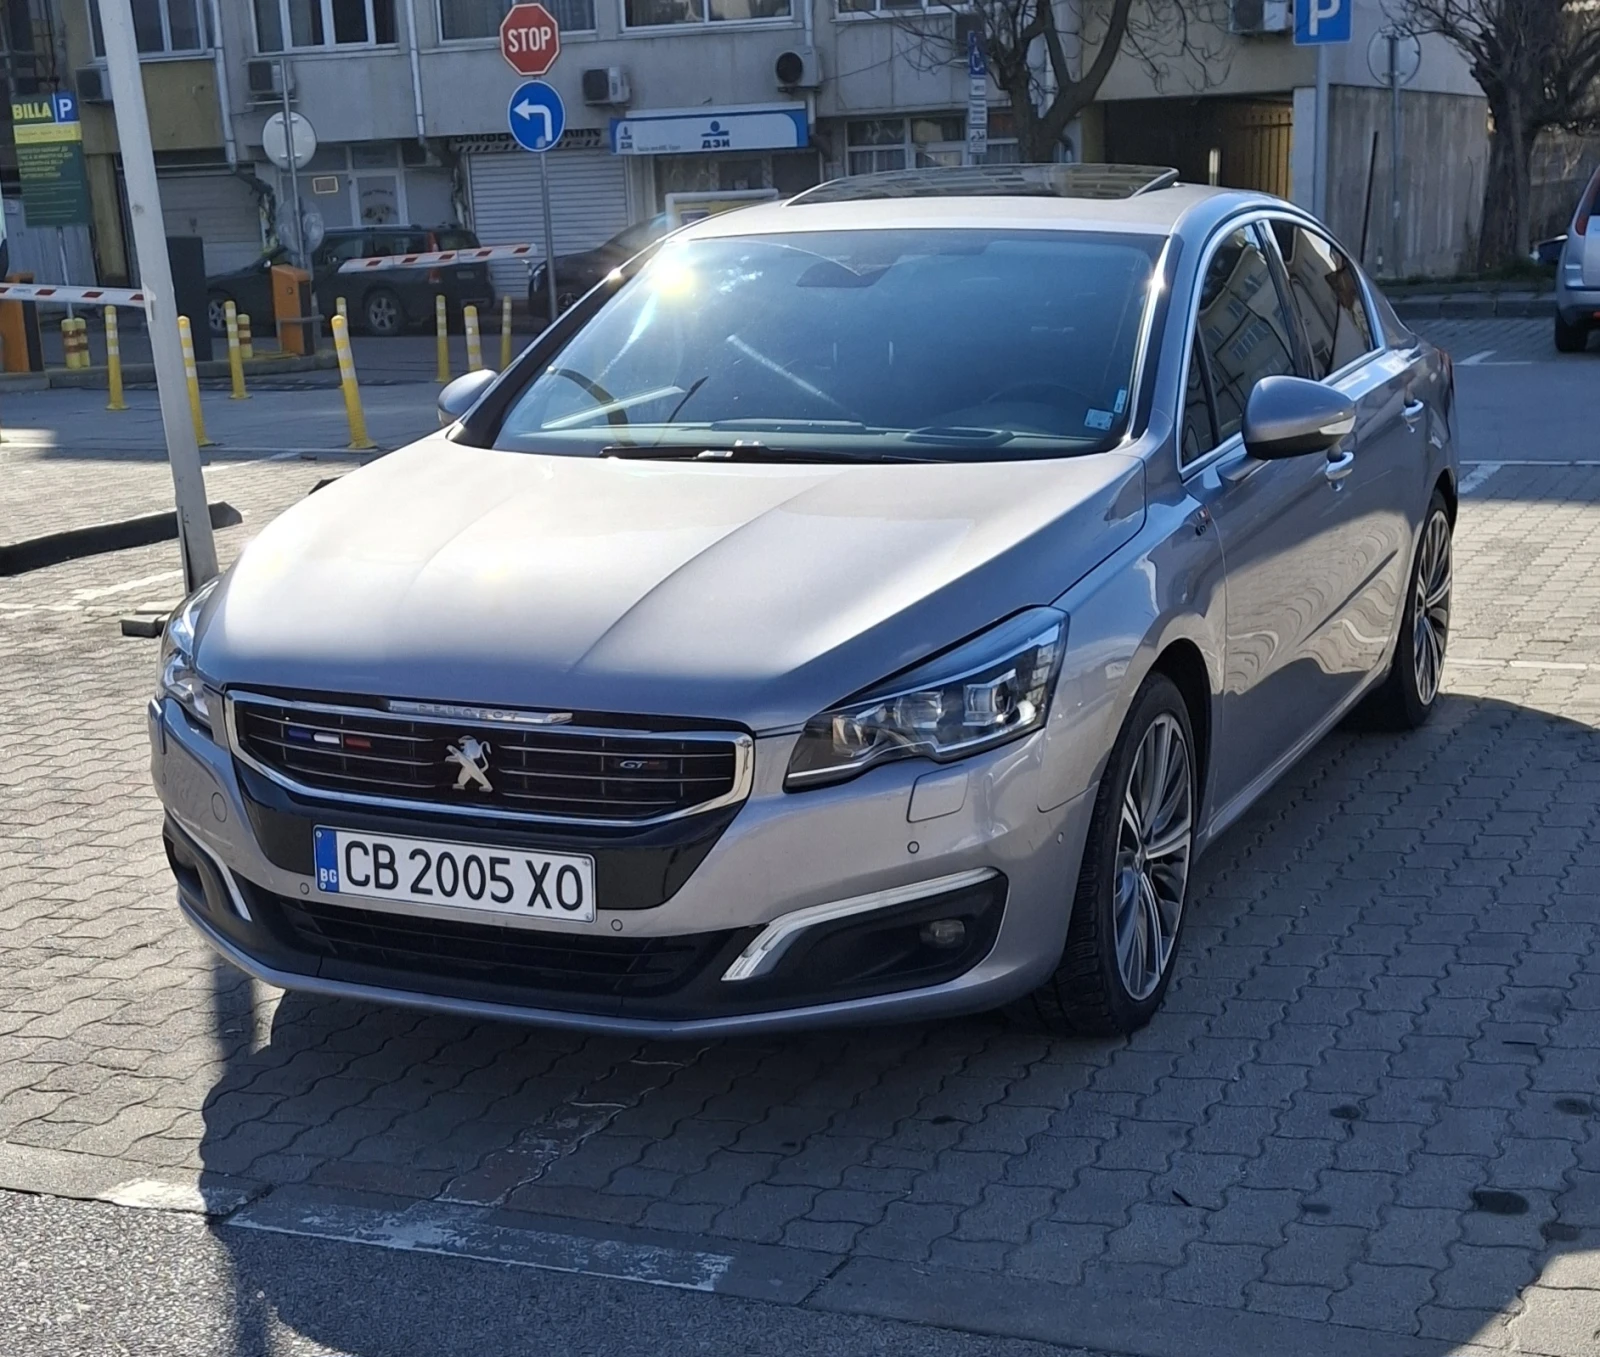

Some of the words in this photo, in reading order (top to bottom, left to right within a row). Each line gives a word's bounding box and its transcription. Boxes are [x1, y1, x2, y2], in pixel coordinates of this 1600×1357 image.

[1309, 0, 1341, 36] P
[507, 26, 552, 53] STOP
[11, 102, 53, 120] BILLA
[58, 98, 73, 118] P
[701, 138, 731, 149] ДЗИ
[417, 704, 519, 720] PEUGEOT
[620, 760, 648, 769] GT
[320, 867, 338, 883] BG
[345, 840, 399, 891] CB
[408, 847, 515, 904] 2005
[525, 859, 584, 912] XO
